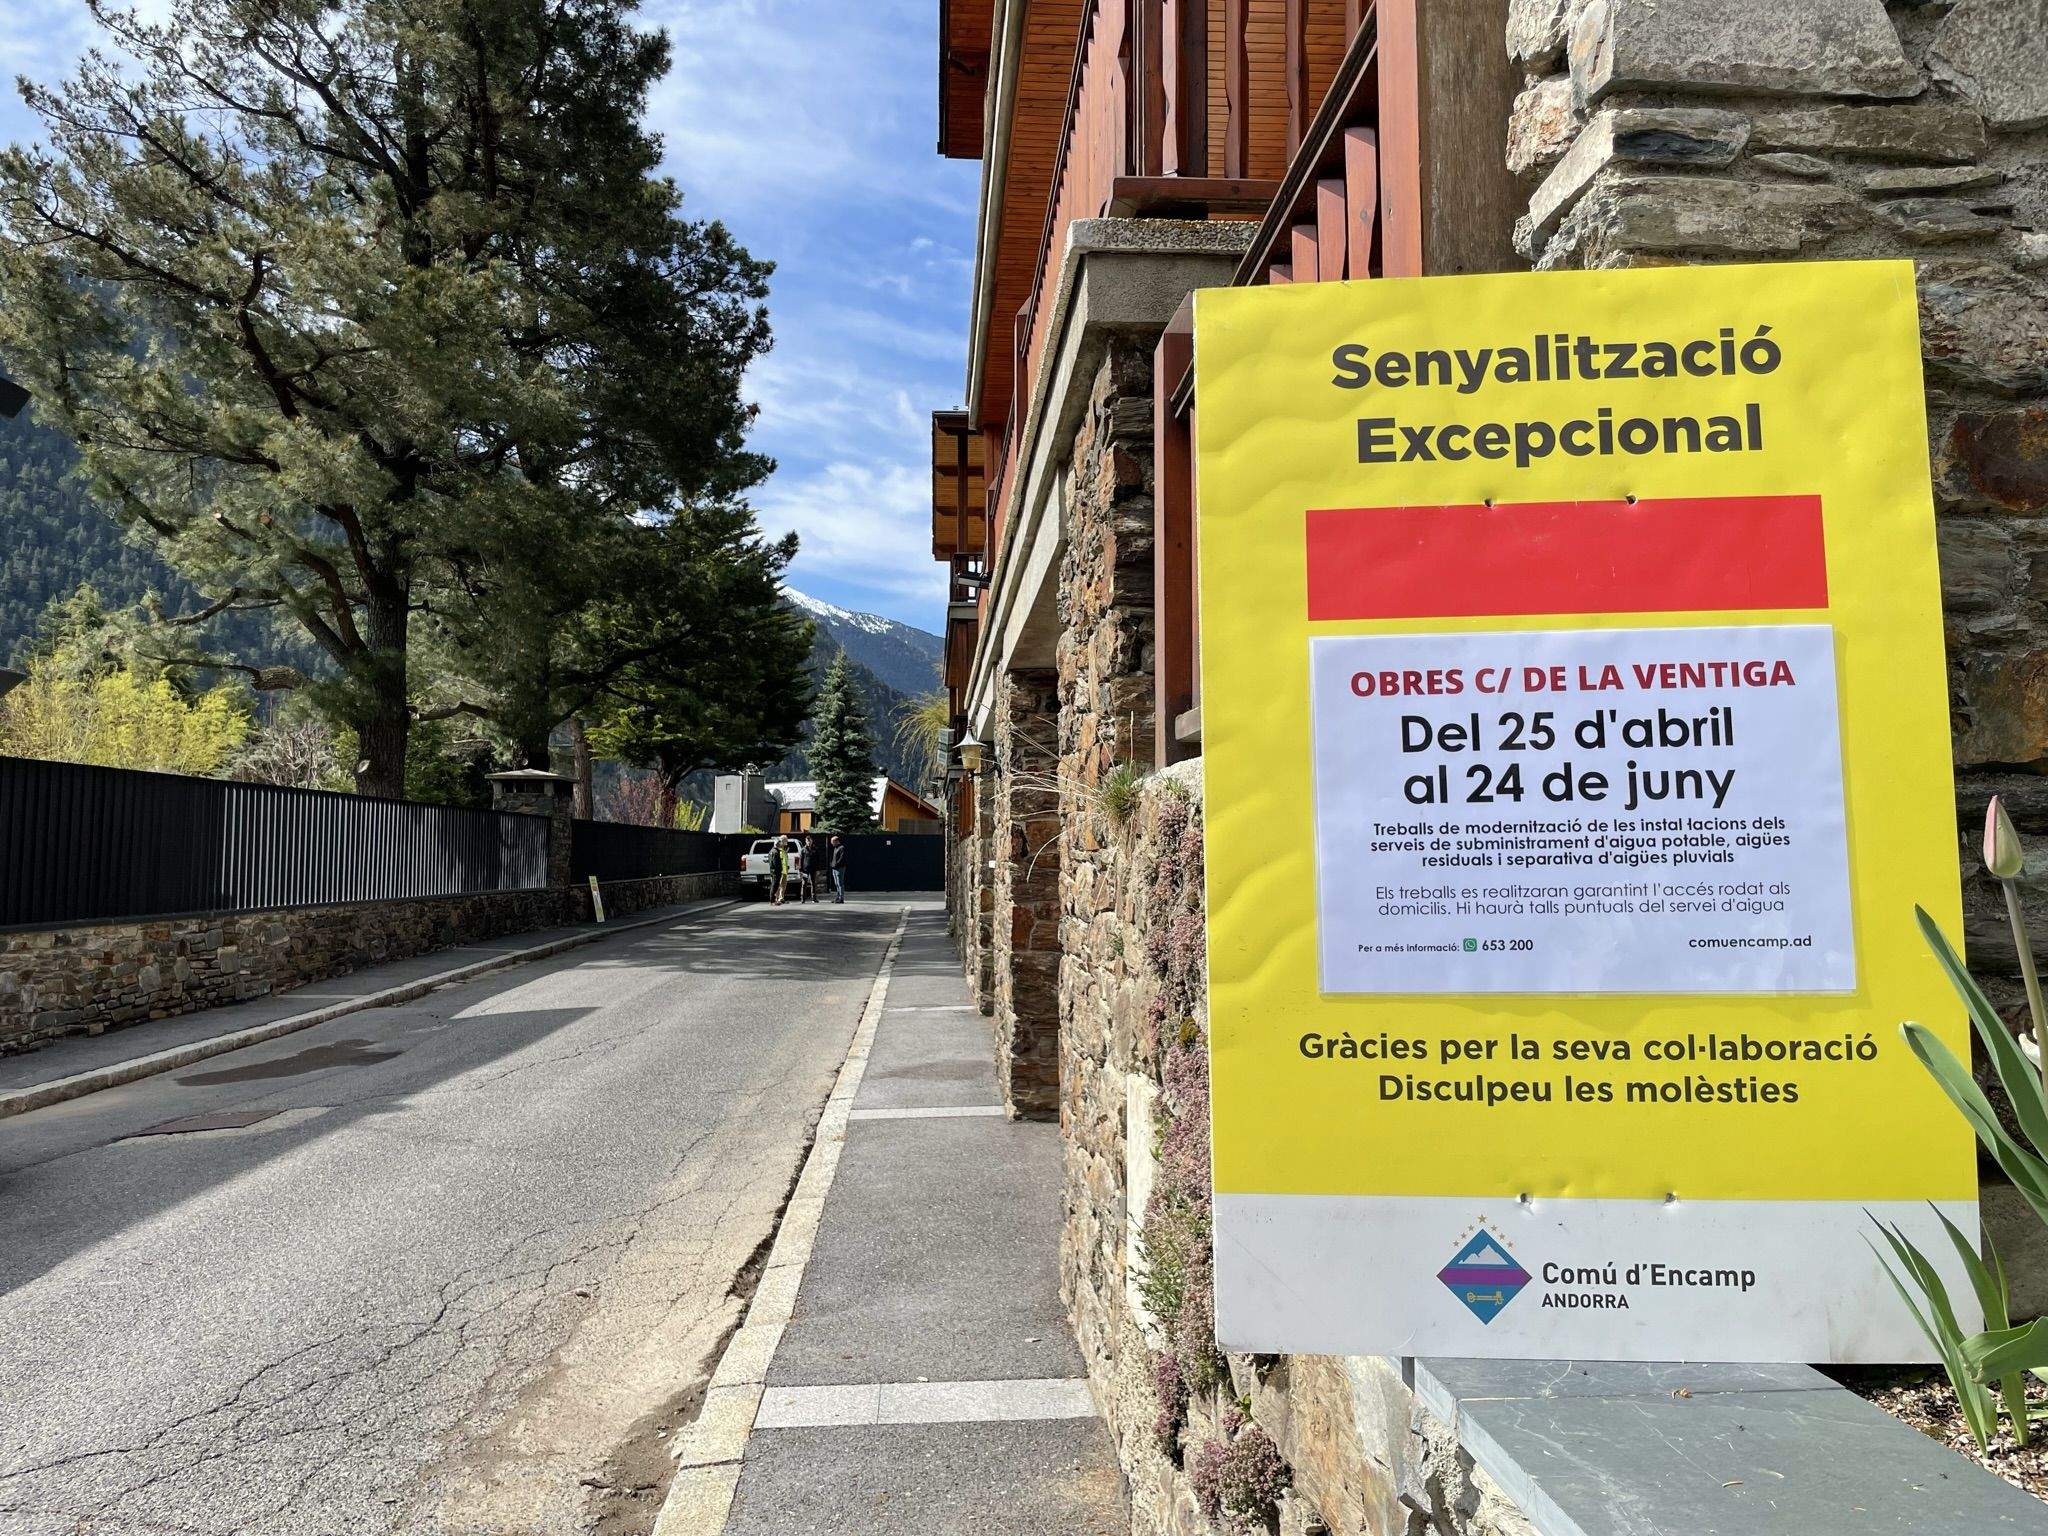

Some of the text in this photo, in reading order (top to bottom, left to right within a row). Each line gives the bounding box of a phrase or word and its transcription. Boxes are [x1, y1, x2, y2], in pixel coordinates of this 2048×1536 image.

[1330, 324, 1782, 395] Senyalització
[1357, 402, 1763, 469] Excepcional
[1350, 660, 1796, 698] OBRES C/ DE LA VENTIGA
[1401, 712, 1481, 753] Del
[1498, 711, 1556, 751] 25
[1403, 759, 1736, 811] al 24 de juny
[1373, 822, 1434, 836] Treballs
[1439, 821, 1460, 835] de
[1465, 818, 1583, 834] modernització
[1587, 818, 1609, 832] de
[1614, 818, 1636, 832] les
[1752, 816, 1786, 830] dels
[1370, 837, 1426, 852] serveis
[1430, 837, 1451, 851] de
[1456, 835, 1590, 850] subministrament
[1661, 834, 1731, 850] potable,
[1735, 833, 1791, 849] aigües
[1422, 853, 1493, 867] residuals
[1497, 852, 1502, 866] i
[1506, 851, 1593, 869] separativa
[1672, 850, 1735, 867] pluvials
[1376, 886, 1395, 900] Els
[1398, 885, 1457, 900] treballs
[1461, 888, 1479, 899] es
[1482, 884, 1569, 899] realitzaran
[1573, 882, 1649, 900] garantint
[1718, 881, 1764, 896] rodat
[1768, 881, 1791, 895] als
[1378, 901, 1451, 916] domicilis.
[1456, 901, 1471, 915] Hi
[1475, 899, 1524, 915] haurà
[1529, 900, 1560, 914] talls
[1564, 899, 1634, 917] puntuals
[1638, 898, 1665, 913] del
[1669, 898, 1716, 913] servei
[1358, 942, 1460, 953] Per a més informació:
[1481, 939, 1534, 952] 653 200
[1688, 934, 1812, 950] comuencamp.ad
[1299, 1031, 1428, 1060] Gràcies
[1440, 1039, 1499, 1065] per
[1510, 1033, 1540, 1061] la
[1552, 1039, 1631, 1061] seva
[1379, 1074, 1799, 1107] Disculpeu les molèsties
[1541, 1259, 1618, 1288] Comú
[1541, 1293, 1630, 1310] ANDORRA
